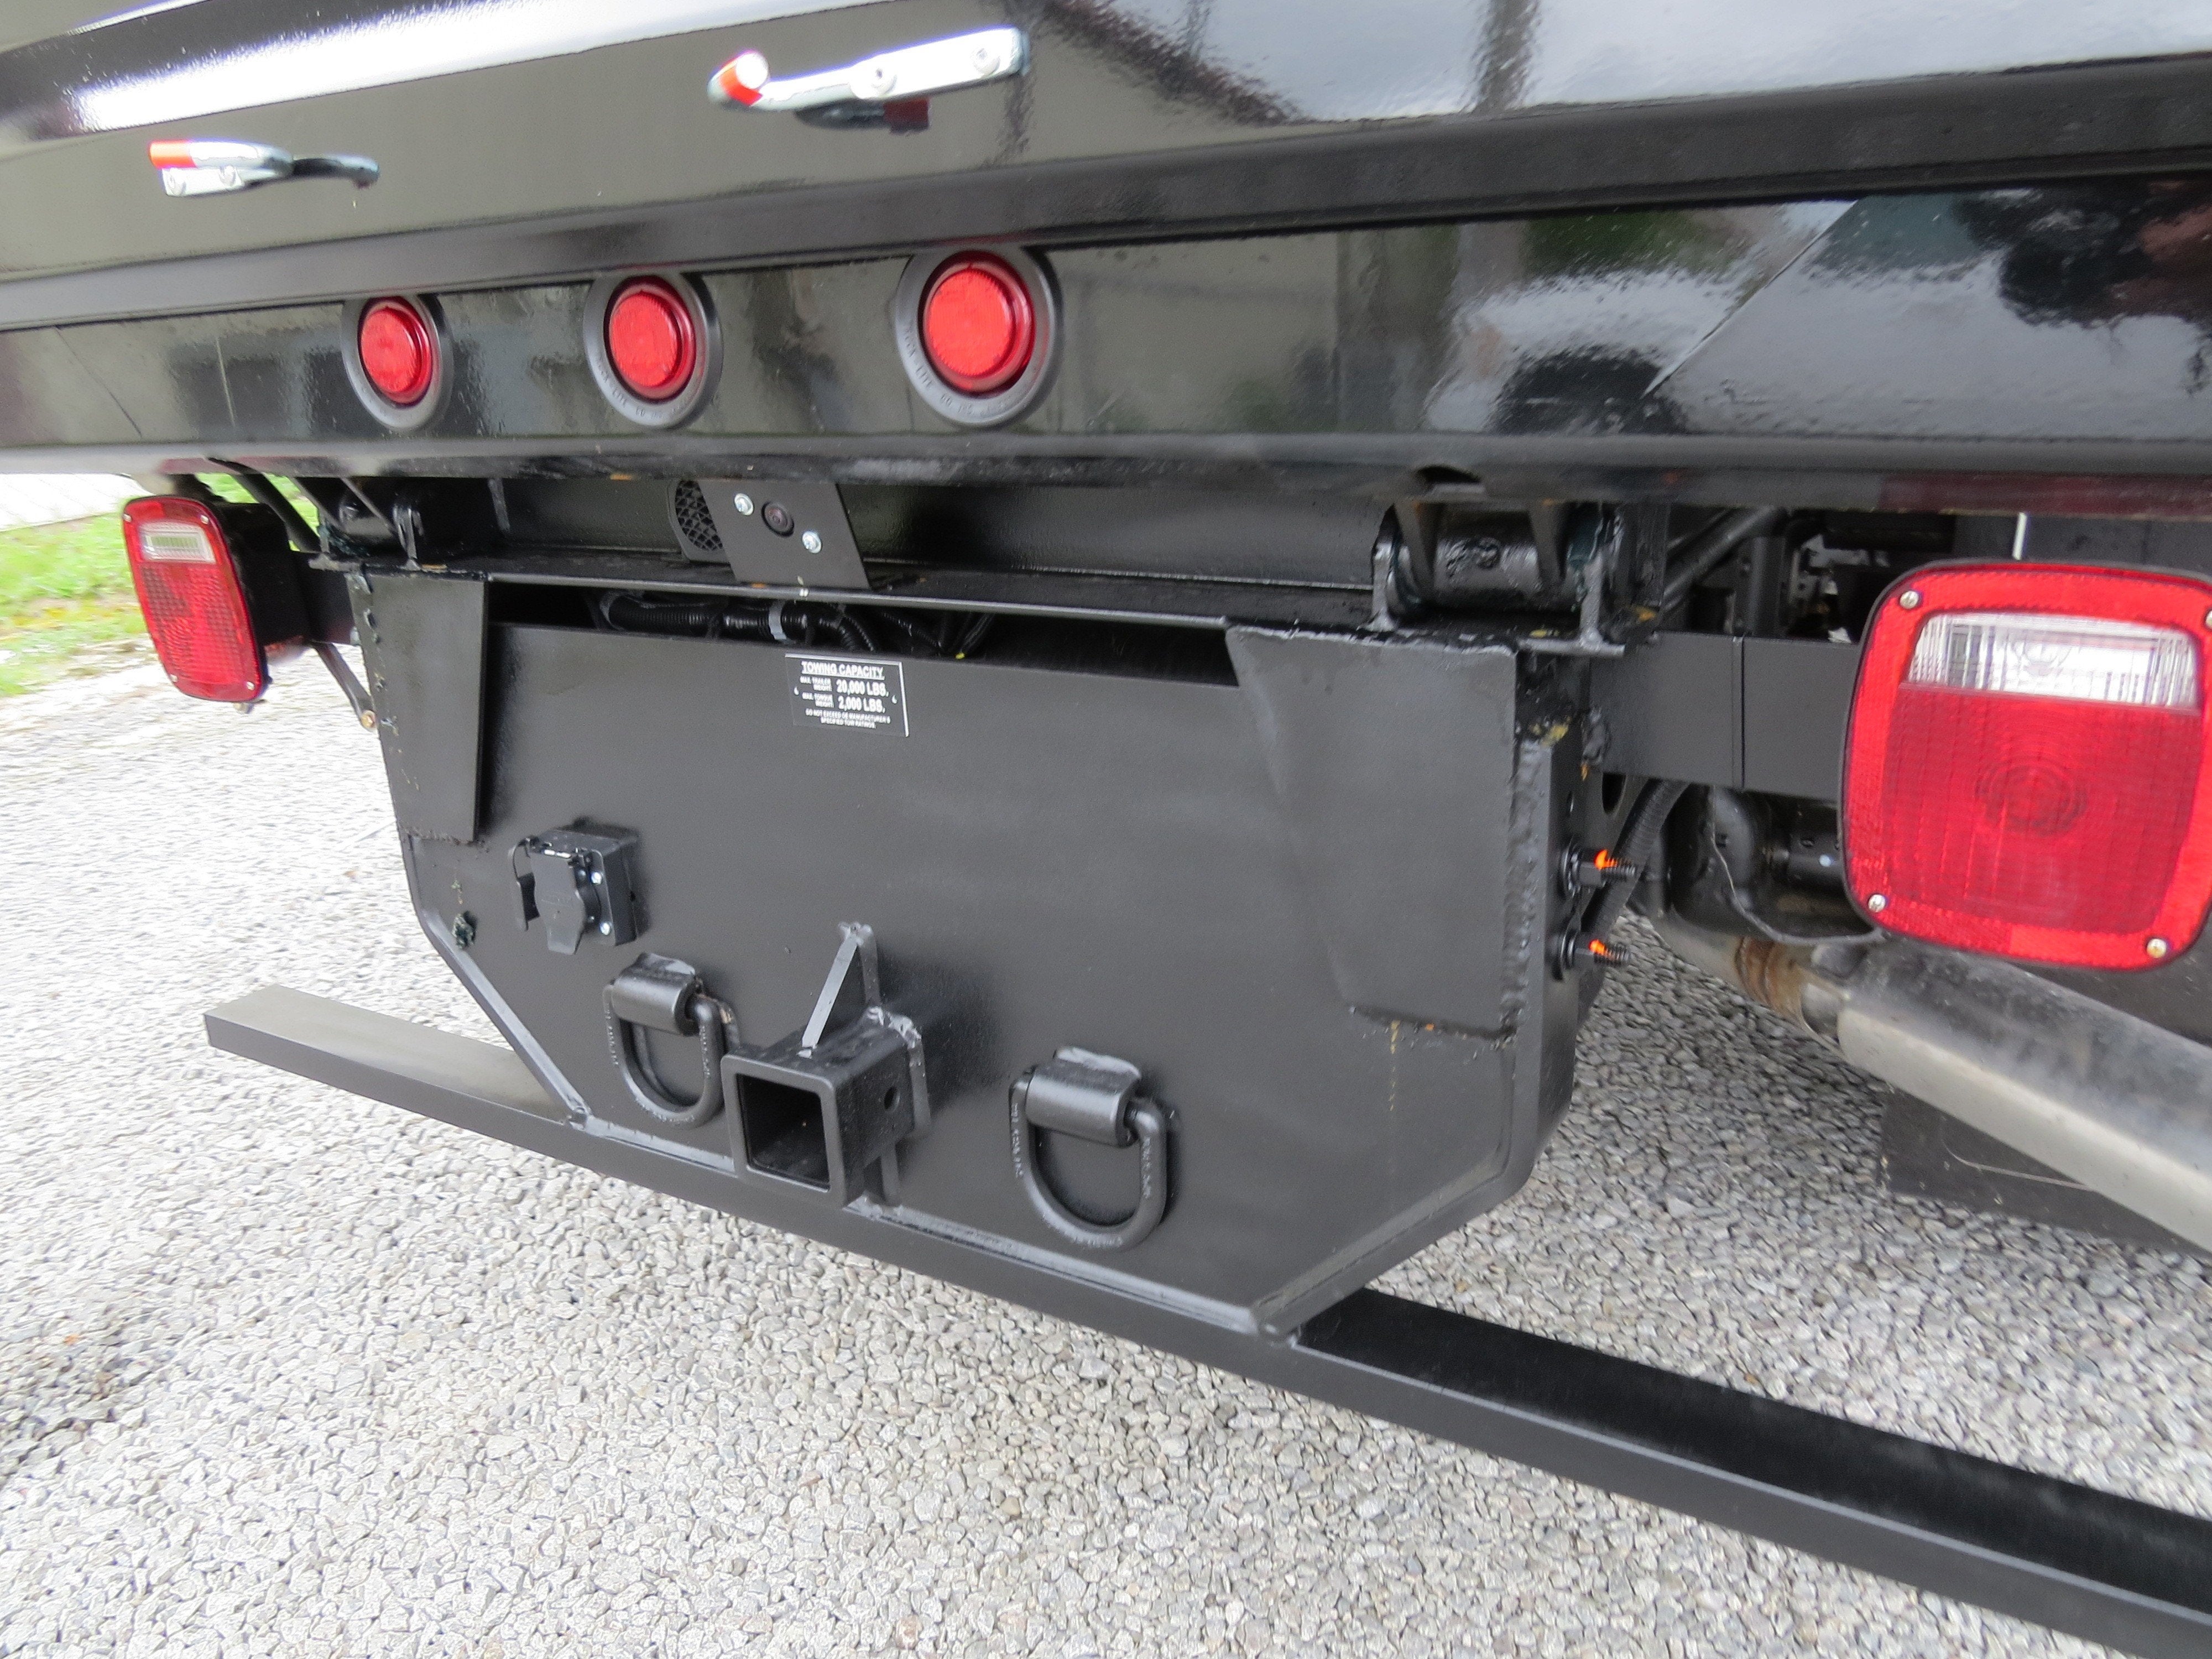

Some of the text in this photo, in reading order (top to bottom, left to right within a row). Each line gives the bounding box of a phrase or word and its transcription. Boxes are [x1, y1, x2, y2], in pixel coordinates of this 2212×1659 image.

[801, 661, 884, 678] TOWING CAPACITY
[836, 679, 865, 695] 20,000
[838, 695, 862, 711] 2,000
